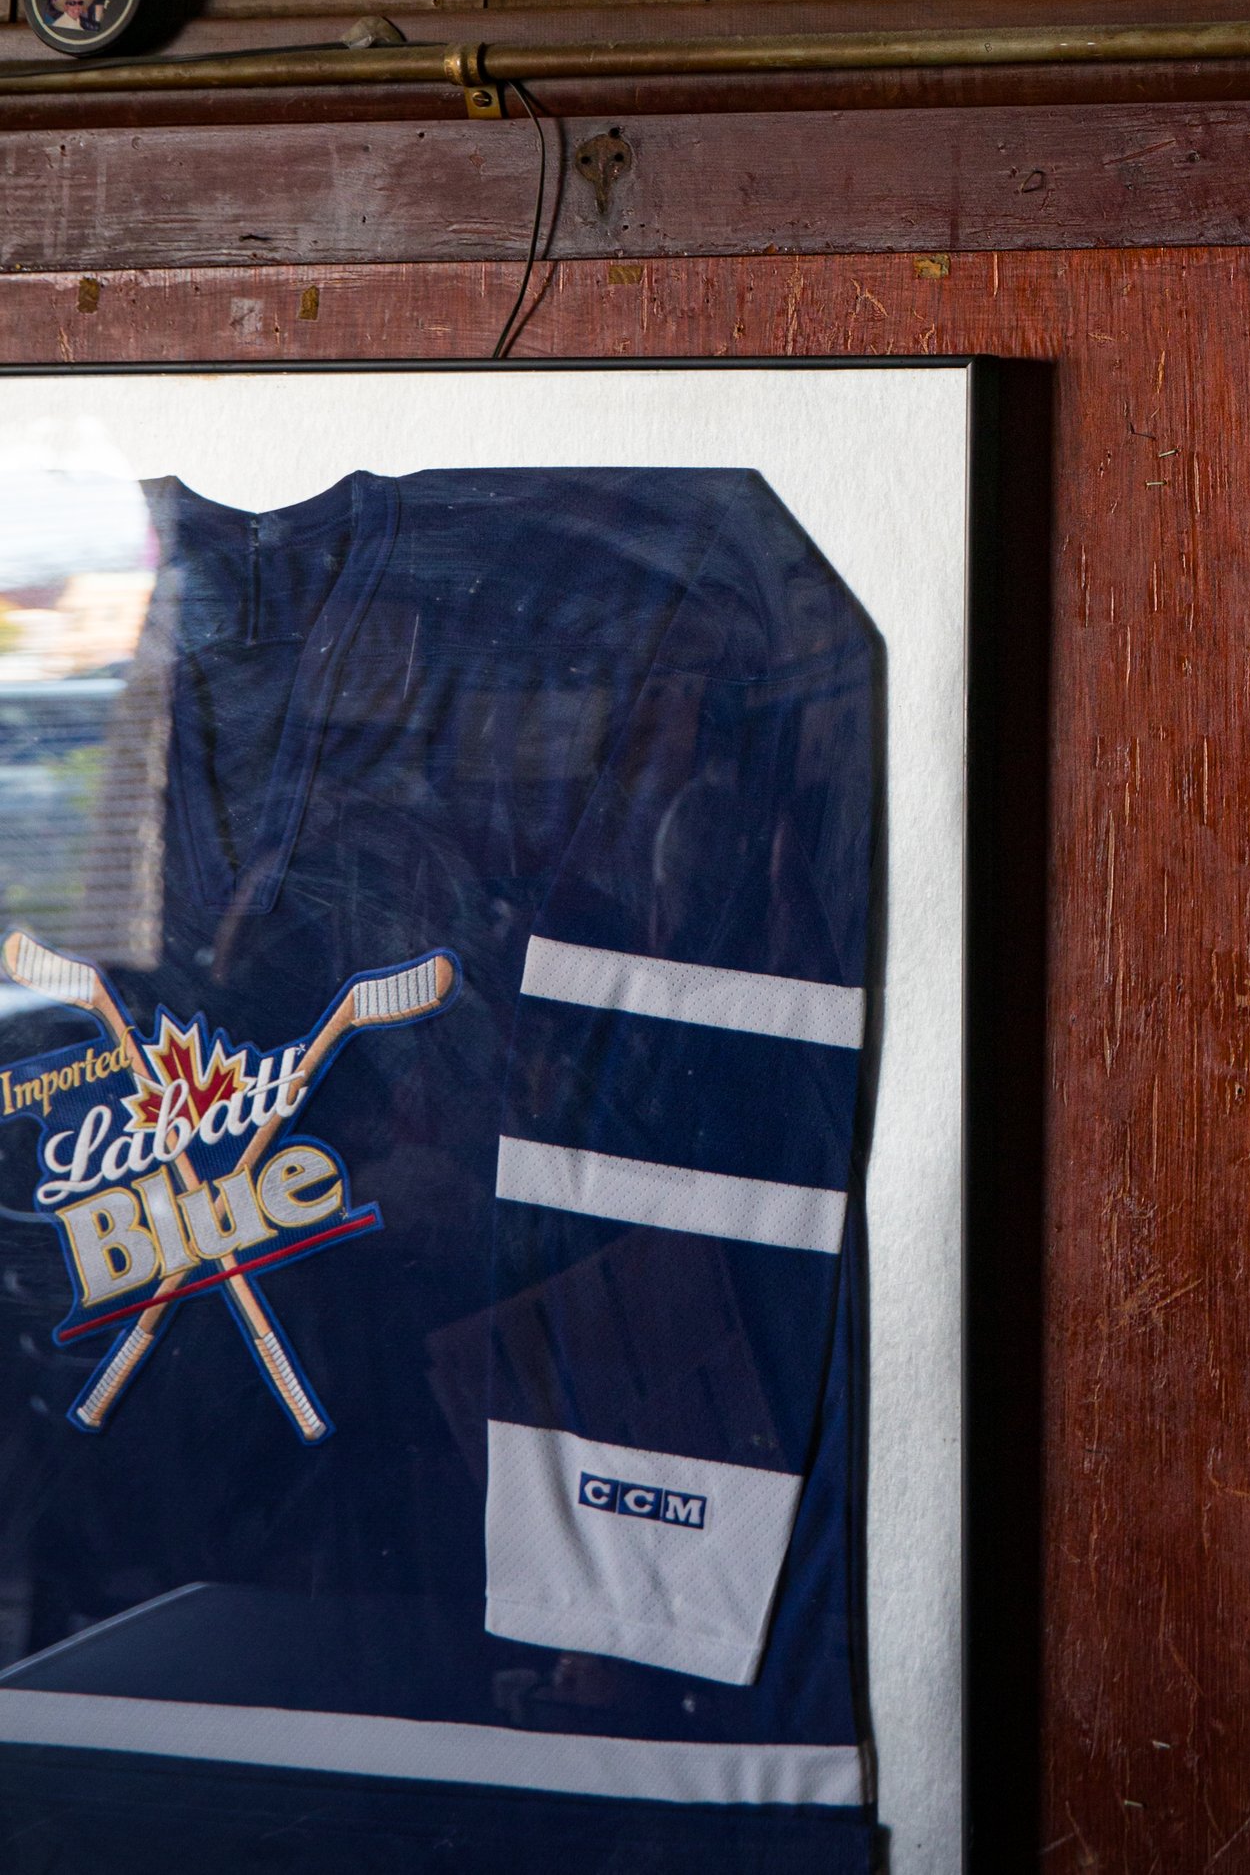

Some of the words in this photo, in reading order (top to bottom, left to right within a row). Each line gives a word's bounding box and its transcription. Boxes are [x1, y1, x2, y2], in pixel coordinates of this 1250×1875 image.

[0, 1026, 136, 1117] Imported
[36, 1047, 309, 1205] Labatt
[56, 1145, 346, 1308] Blue
[580, 1474, 706, 1528] CCM
